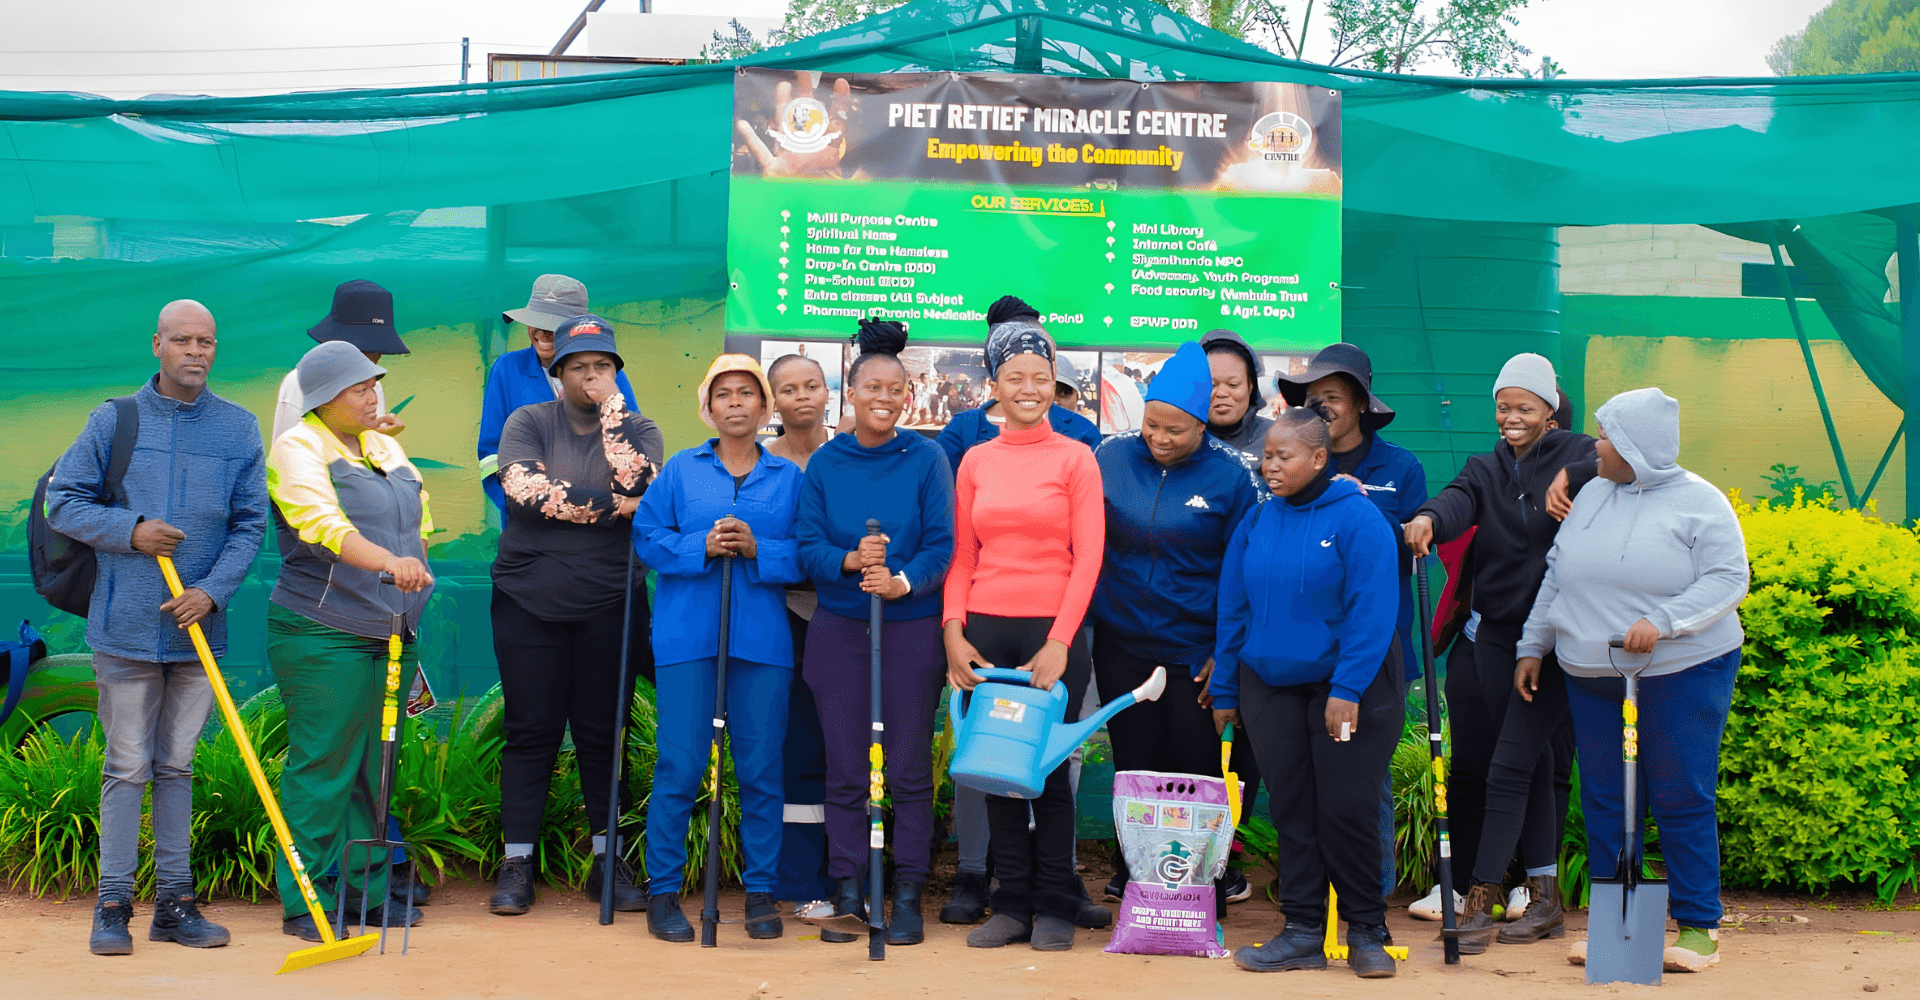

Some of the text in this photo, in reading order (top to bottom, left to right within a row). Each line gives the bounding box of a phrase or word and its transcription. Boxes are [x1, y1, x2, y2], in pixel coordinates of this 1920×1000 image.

[889, 103, 1228, 138] PIET RETIEF MIRACLE CENTRE
[927, 137, 1184, 171] Empowering the Community
[971, 194, 1006, 209] OUR
[841, 212, 892, 227] Purpose
[894, 214, 939, 227] Centre
[807, 227, 898, 241] Spiritual Home
[1132, 223, 1204, 239] Mini Library
[806, 243, 949, 259] Home for the Homeless
[1132, 238, 1183, 251] Internet
[805, 257, 857, 272] Drop-In
[859, 259, 902, 272] Centre
[804, 273, 875, 287] Pre-School
[1203, 271, 1239, 283] Youth
[916, 292, 964, 307] Subject
[1131, 283, 1163, 296] Food
[1165, 286, 1216, 300] security
[1279, 290, 1308, 302] Trust
[803, 304, 866, 320] Pharmacy
[1130, 316, 1170, 328] EPWP
